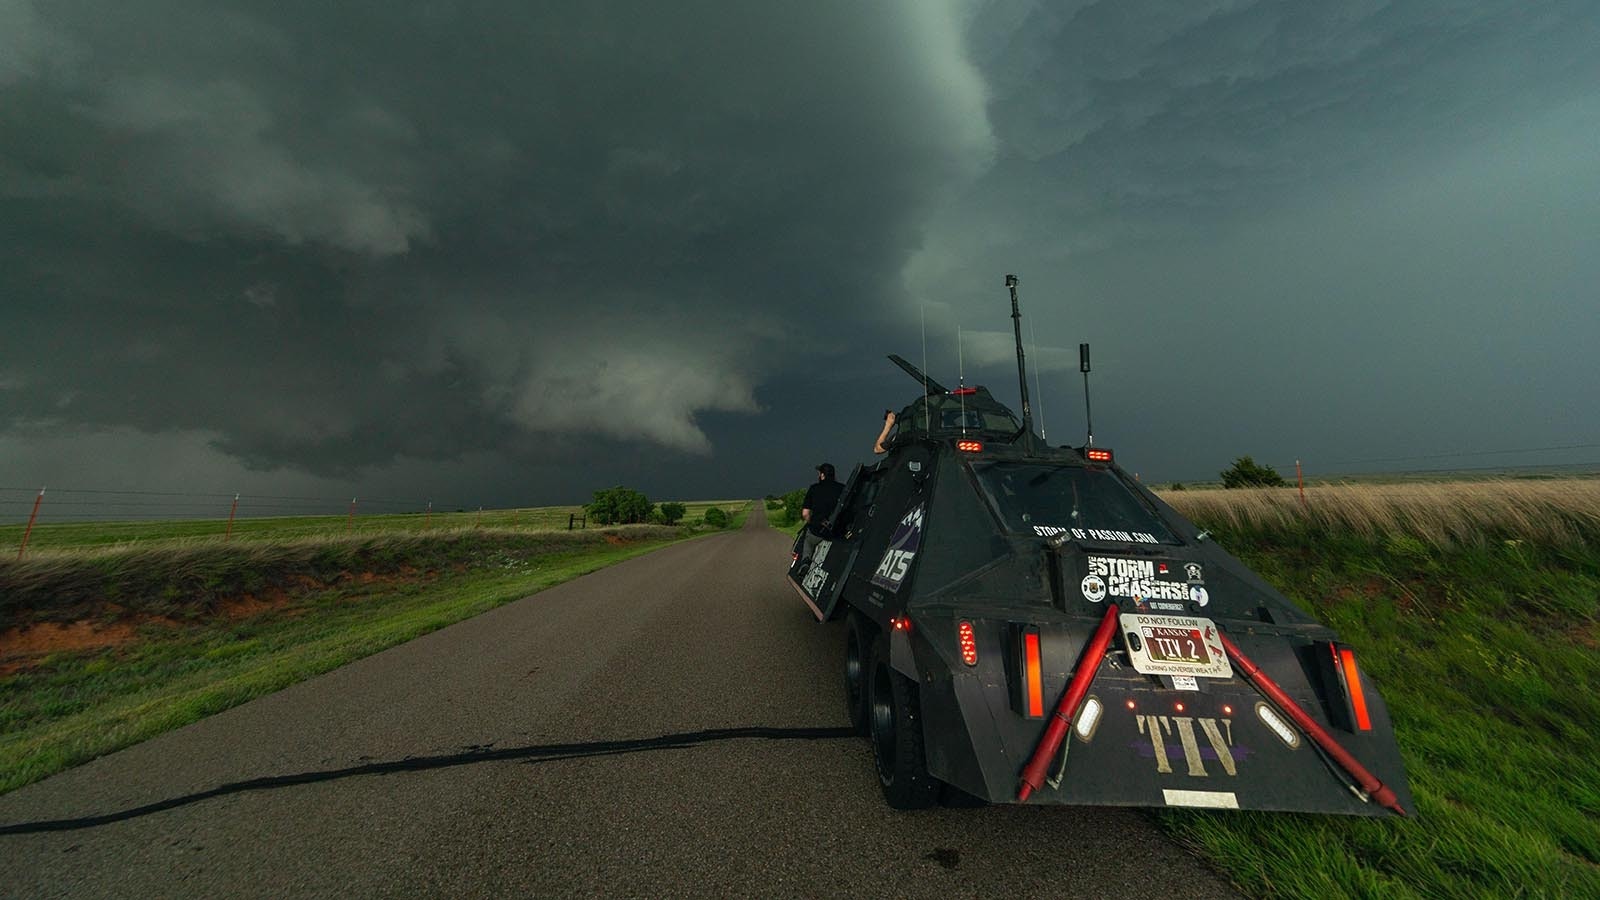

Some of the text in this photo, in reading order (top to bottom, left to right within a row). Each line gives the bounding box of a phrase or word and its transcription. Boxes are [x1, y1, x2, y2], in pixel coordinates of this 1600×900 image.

[1071, 528, 1087, 539] OF
[876, 549, 915, 581] ATS
[1088, 556, 1098, 575] LIVE
[1097, 557, 1154, 578] STORM
[1108, 575, 1182, 600] CHASERS
[1137, 616, 1198, 626] DO NOT FOLLOW
[1156, 628, 1188, 637] KANSAS
[1155, 638, 1200, 659] TIV 2
[1145, 664, 1168, 673] DURING
[1169, 666, 1195, 674] ADVERSE
[1136, 715, 1237, 776] TIV
